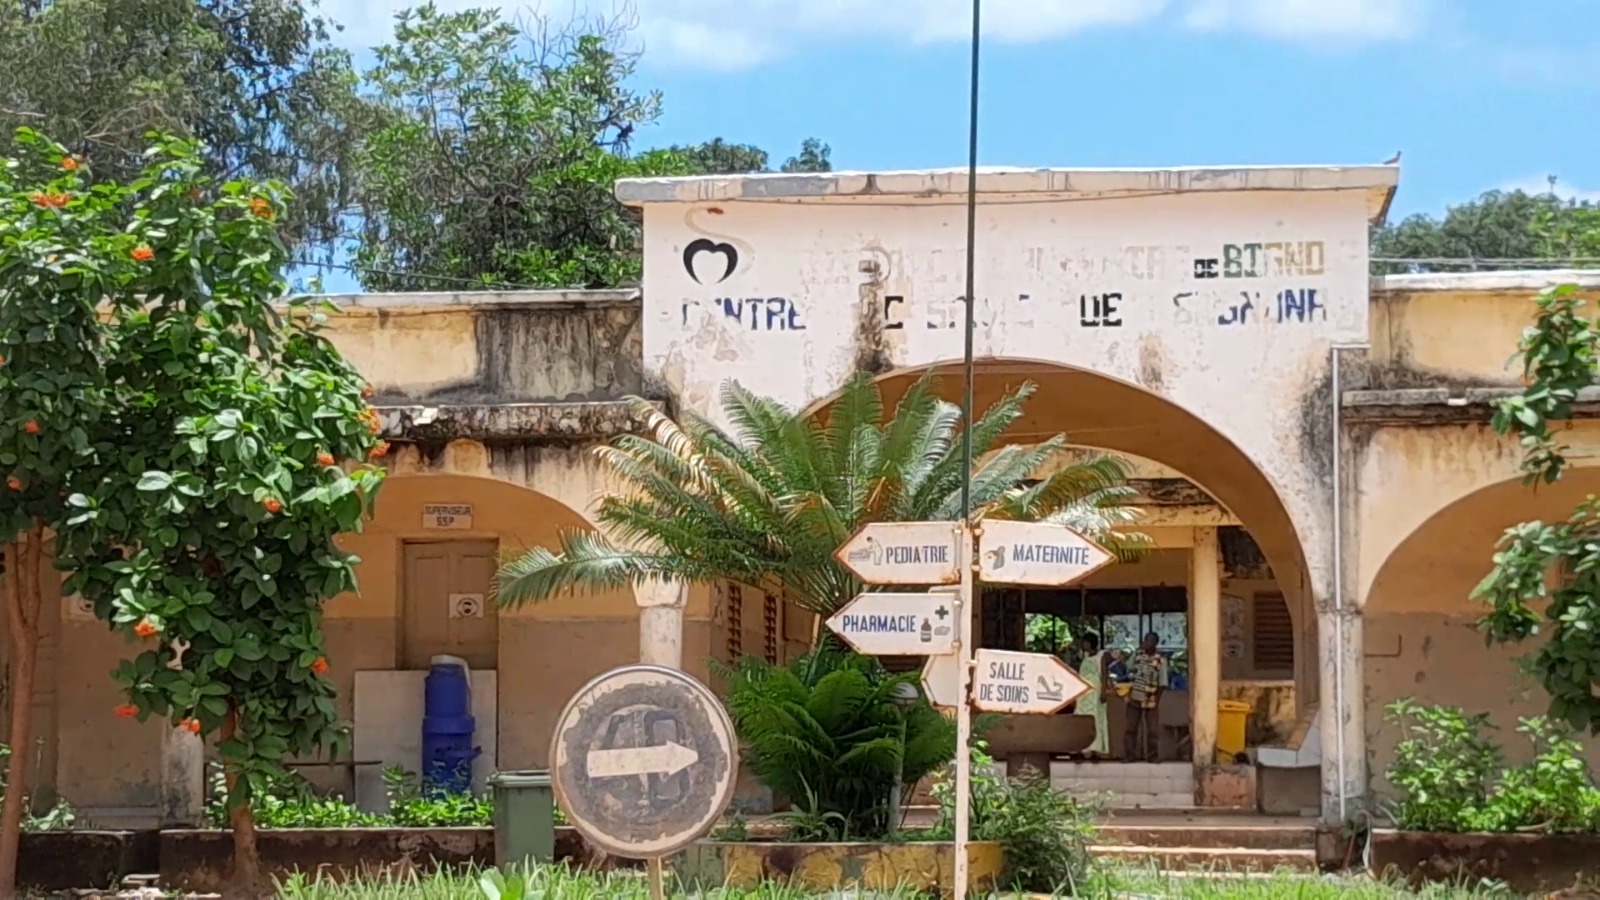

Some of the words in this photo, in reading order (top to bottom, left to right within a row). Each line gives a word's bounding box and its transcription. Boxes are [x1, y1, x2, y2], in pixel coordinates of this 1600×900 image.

[1194, 259, 1219, 279] DE
[885, 545, 949, 564] PEDIATRIE
[1012, 544, 1090, 565] MATERNITE
[842, 614, 917, 633] PHARMACIE
[989, 661, 1026, 681] SALLE
[979, 684, 995, 701] DE
[996, 684, 1030, 704] SOINS
